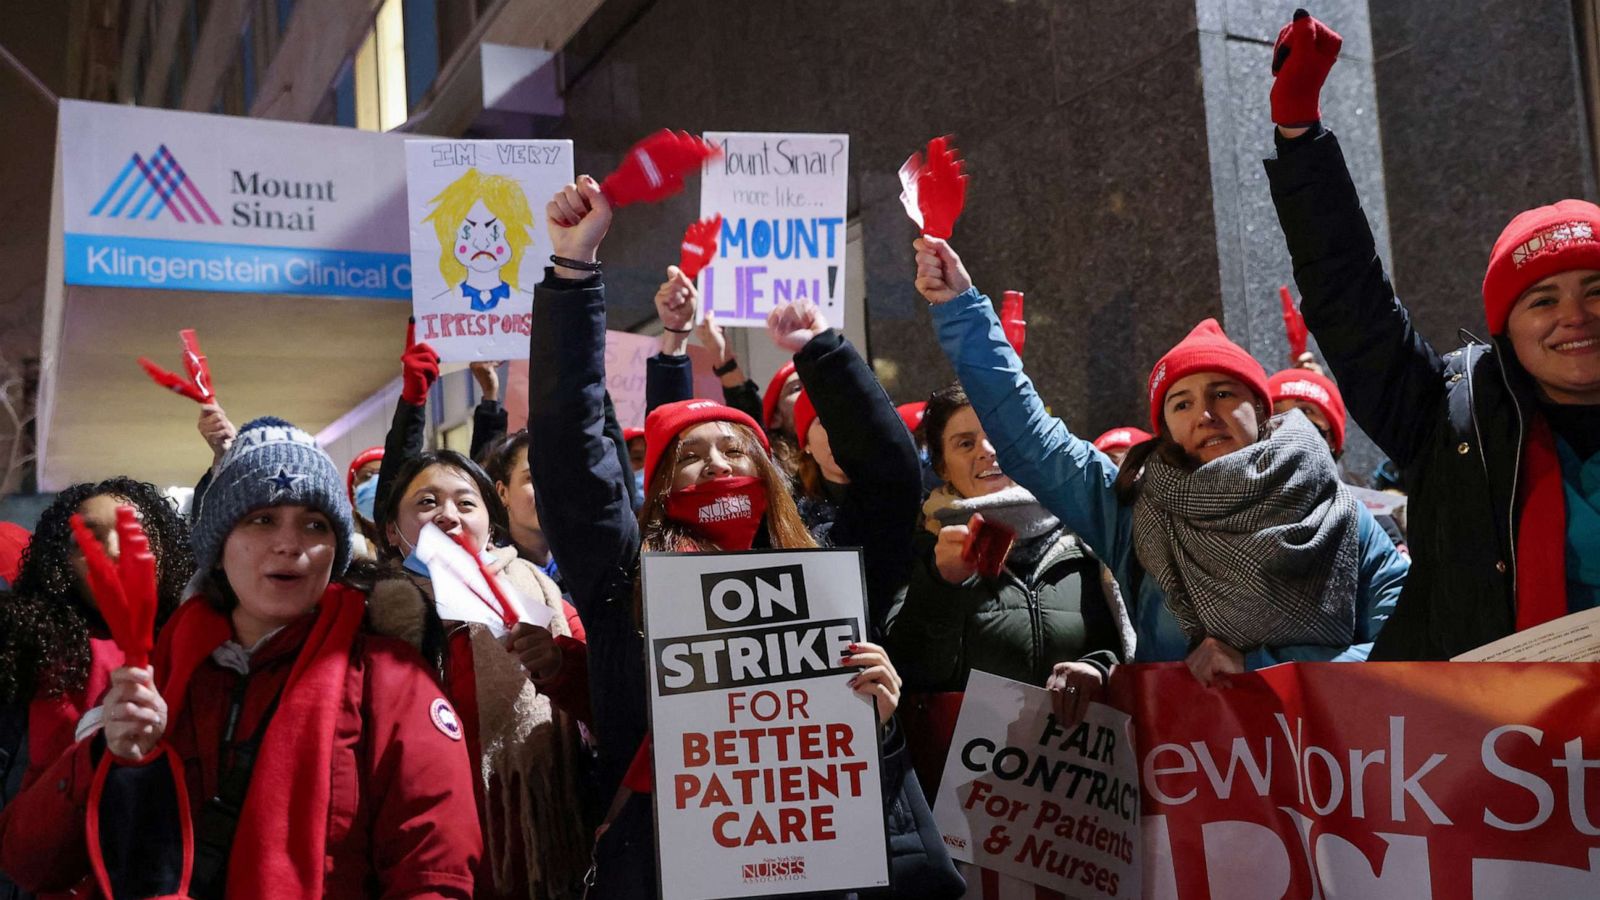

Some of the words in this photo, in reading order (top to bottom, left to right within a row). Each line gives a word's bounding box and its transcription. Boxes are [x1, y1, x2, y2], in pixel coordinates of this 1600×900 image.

[431, 143, 477, 167] IM
[496, 144, 561, 165] VERY
[704, 139, 770, 176] Mount
[774, 139, 844, 176] Sinai?
[230, 169, 337, 203] Mount
[733, 188, 769, 207] more
[231, 202, 316, 232] Sinai
[720, 217, 843, 260] MOUNT
[87, 246, 280, 284] Klingenstein
[284, 257, 387, 290] Clinical
[698, 496, 752, 519] NURSES
[709, 573, 797, 622] ON
[661, 625, 854, 689] STRIKE
[727, 689, 810, 723] FOR
[682, 723, 856, 768] BETTER
[1038, 713, 1117, 766] FAIR
[674, 762, 868, 810] PATIENT
[1273, 712, 1455, 826] York
[711, 804, 837, 848] CARE
[964, 780, 1029, 822] For
[1033, 799, 1134, 865] Patients
[742, 861, 805, 878] NURSES
[743, 873, 807, 884] ASSOCIATION
[983, 825, 1012, 855] &
[1014, 834, 1120, 897] Nurses
